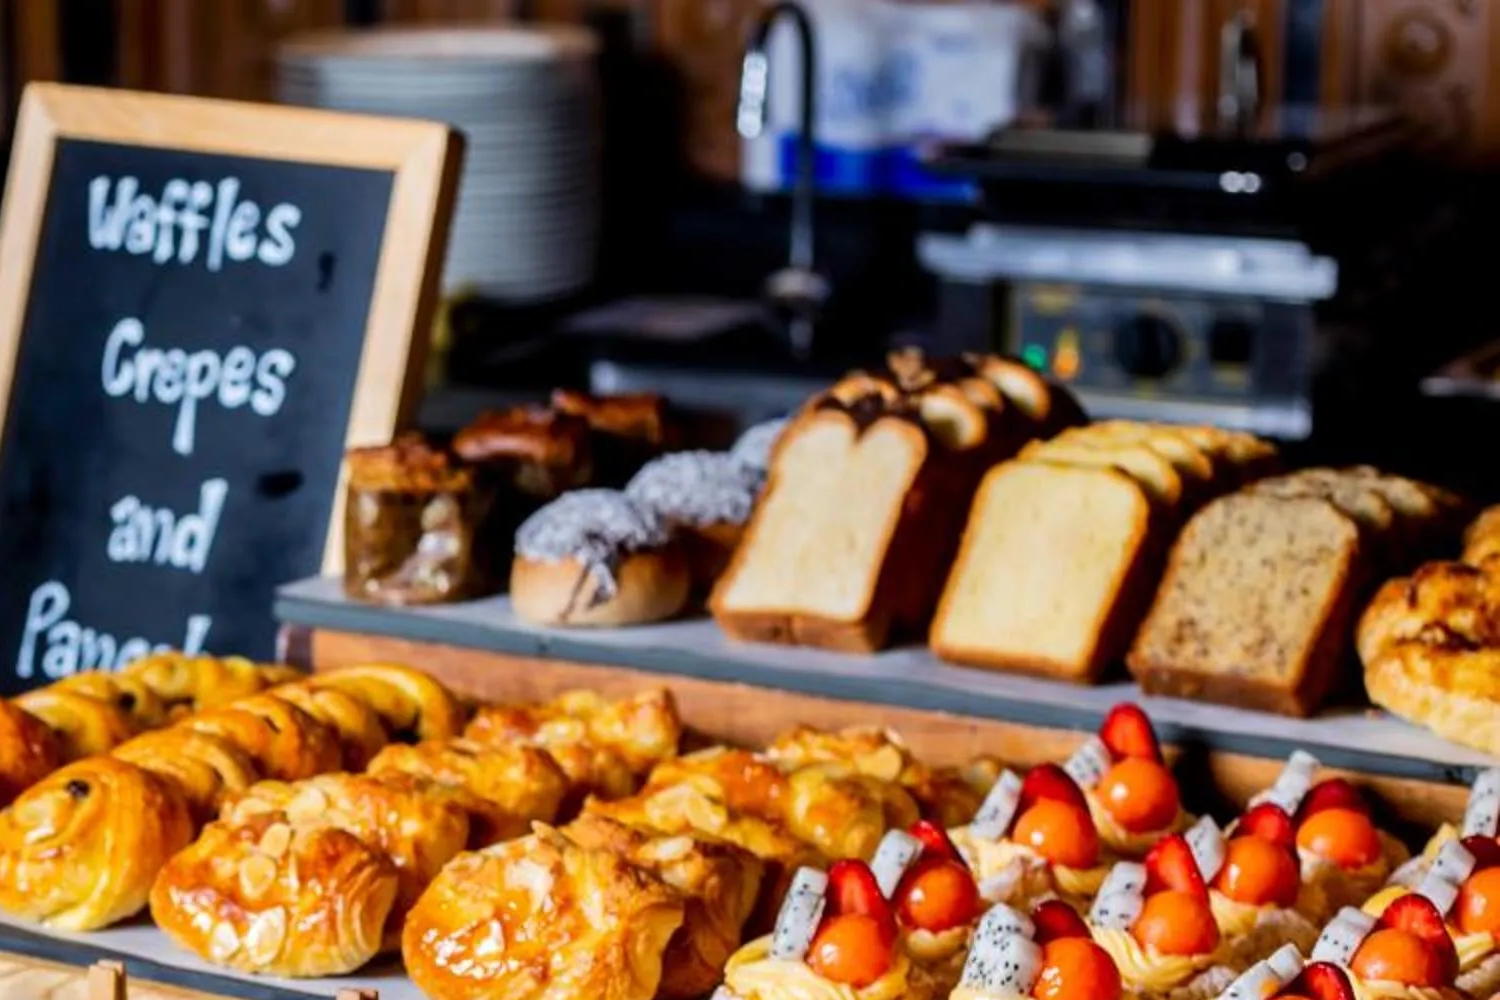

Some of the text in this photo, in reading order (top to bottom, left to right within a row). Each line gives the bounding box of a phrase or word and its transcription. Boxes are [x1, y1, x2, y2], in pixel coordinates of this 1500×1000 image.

[89, 176, 300, 271] Waffles
[102, 318, 295, 456] Crepes
[108, 479, 229, 573] and
